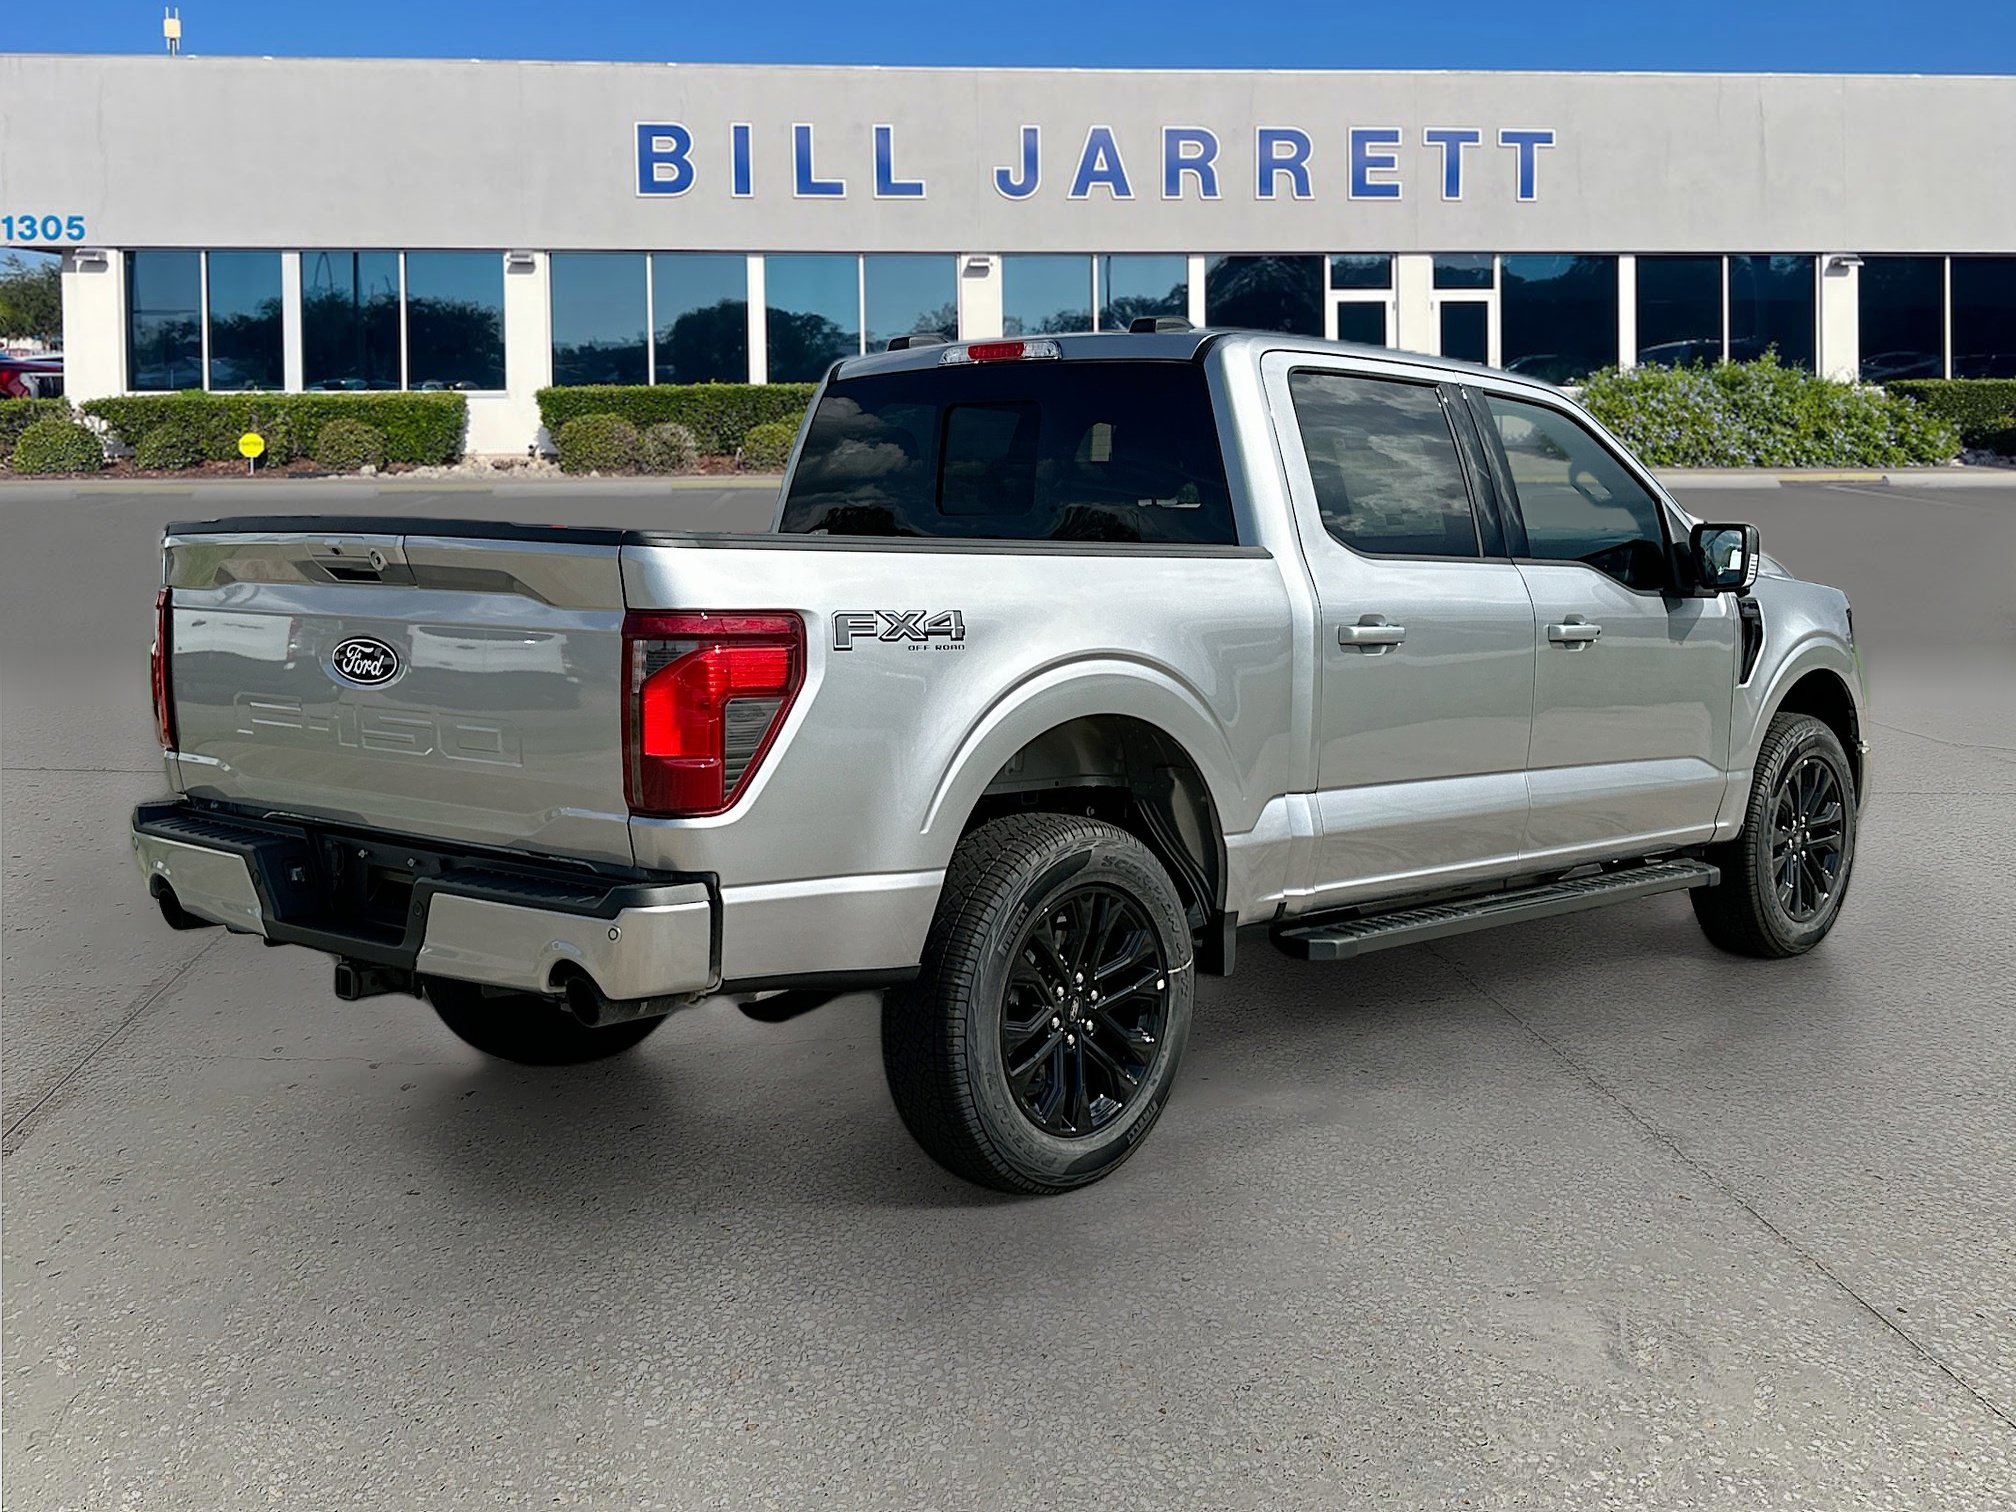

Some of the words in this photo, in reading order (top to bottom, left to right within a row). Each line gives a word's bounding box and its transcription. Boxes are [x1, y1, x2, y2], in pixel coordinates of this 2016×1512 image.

[634, 121, 926, 199] BILL
[993, 125, 1556, 202] JARRETT
[1, 215, 86, 241] 1305
[831, 610, 965, 651] FX4
[342, 643, 385, 676] Ford
[234, 691, 523, 767] F-150
